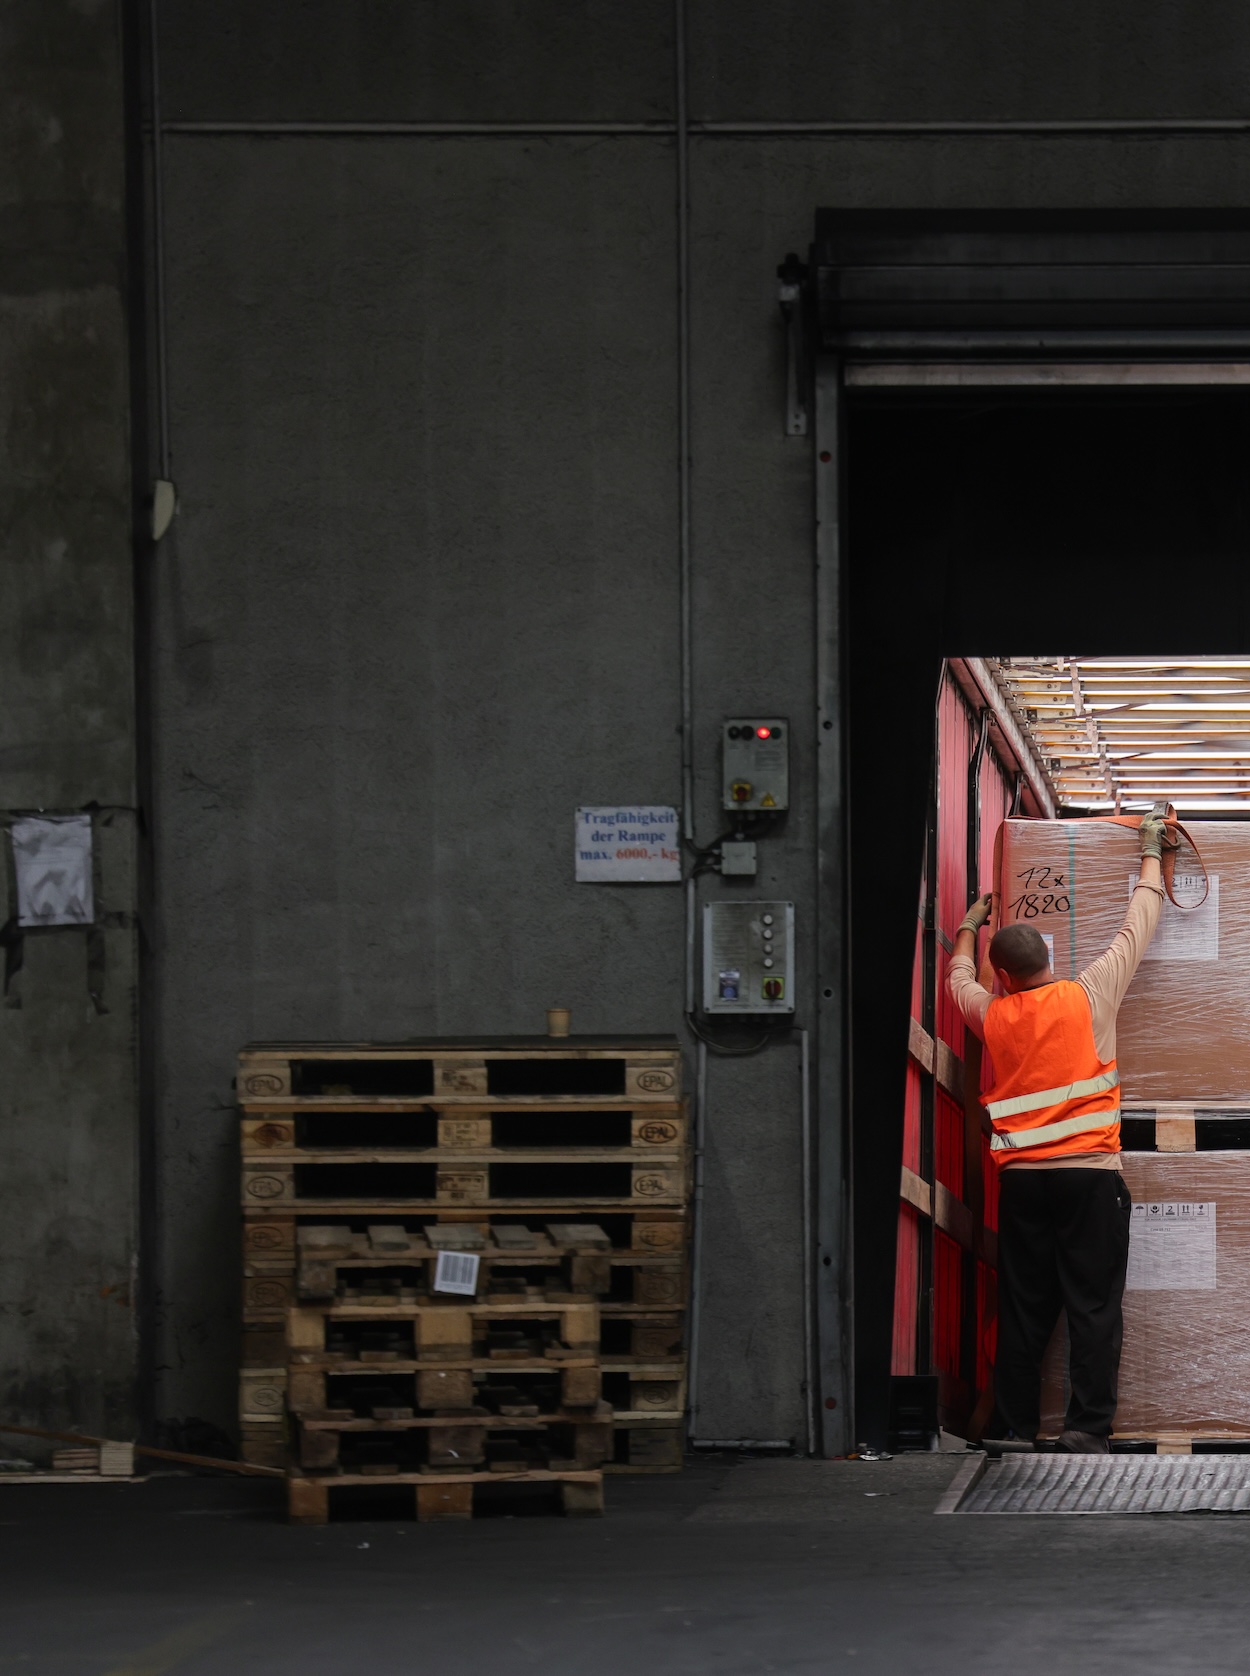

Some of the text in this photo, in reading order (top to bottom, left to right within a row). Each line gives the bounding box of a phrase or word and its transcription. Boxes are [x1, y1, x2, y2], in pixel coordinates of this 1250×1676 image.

[583, 812, 675, 827] Tragfähigkeit
[591, 829, 666, 844] der Rampe
[580, 850, 612, 860] max.
[660, 847, 681, 862] kg
[1016, 867, 1066, 889] 12x
[1008, 894, 1071, 920] 1820
[643, 1074, 670, 1088] EPAL
[643, 1125, 673, 1140] EPAL
